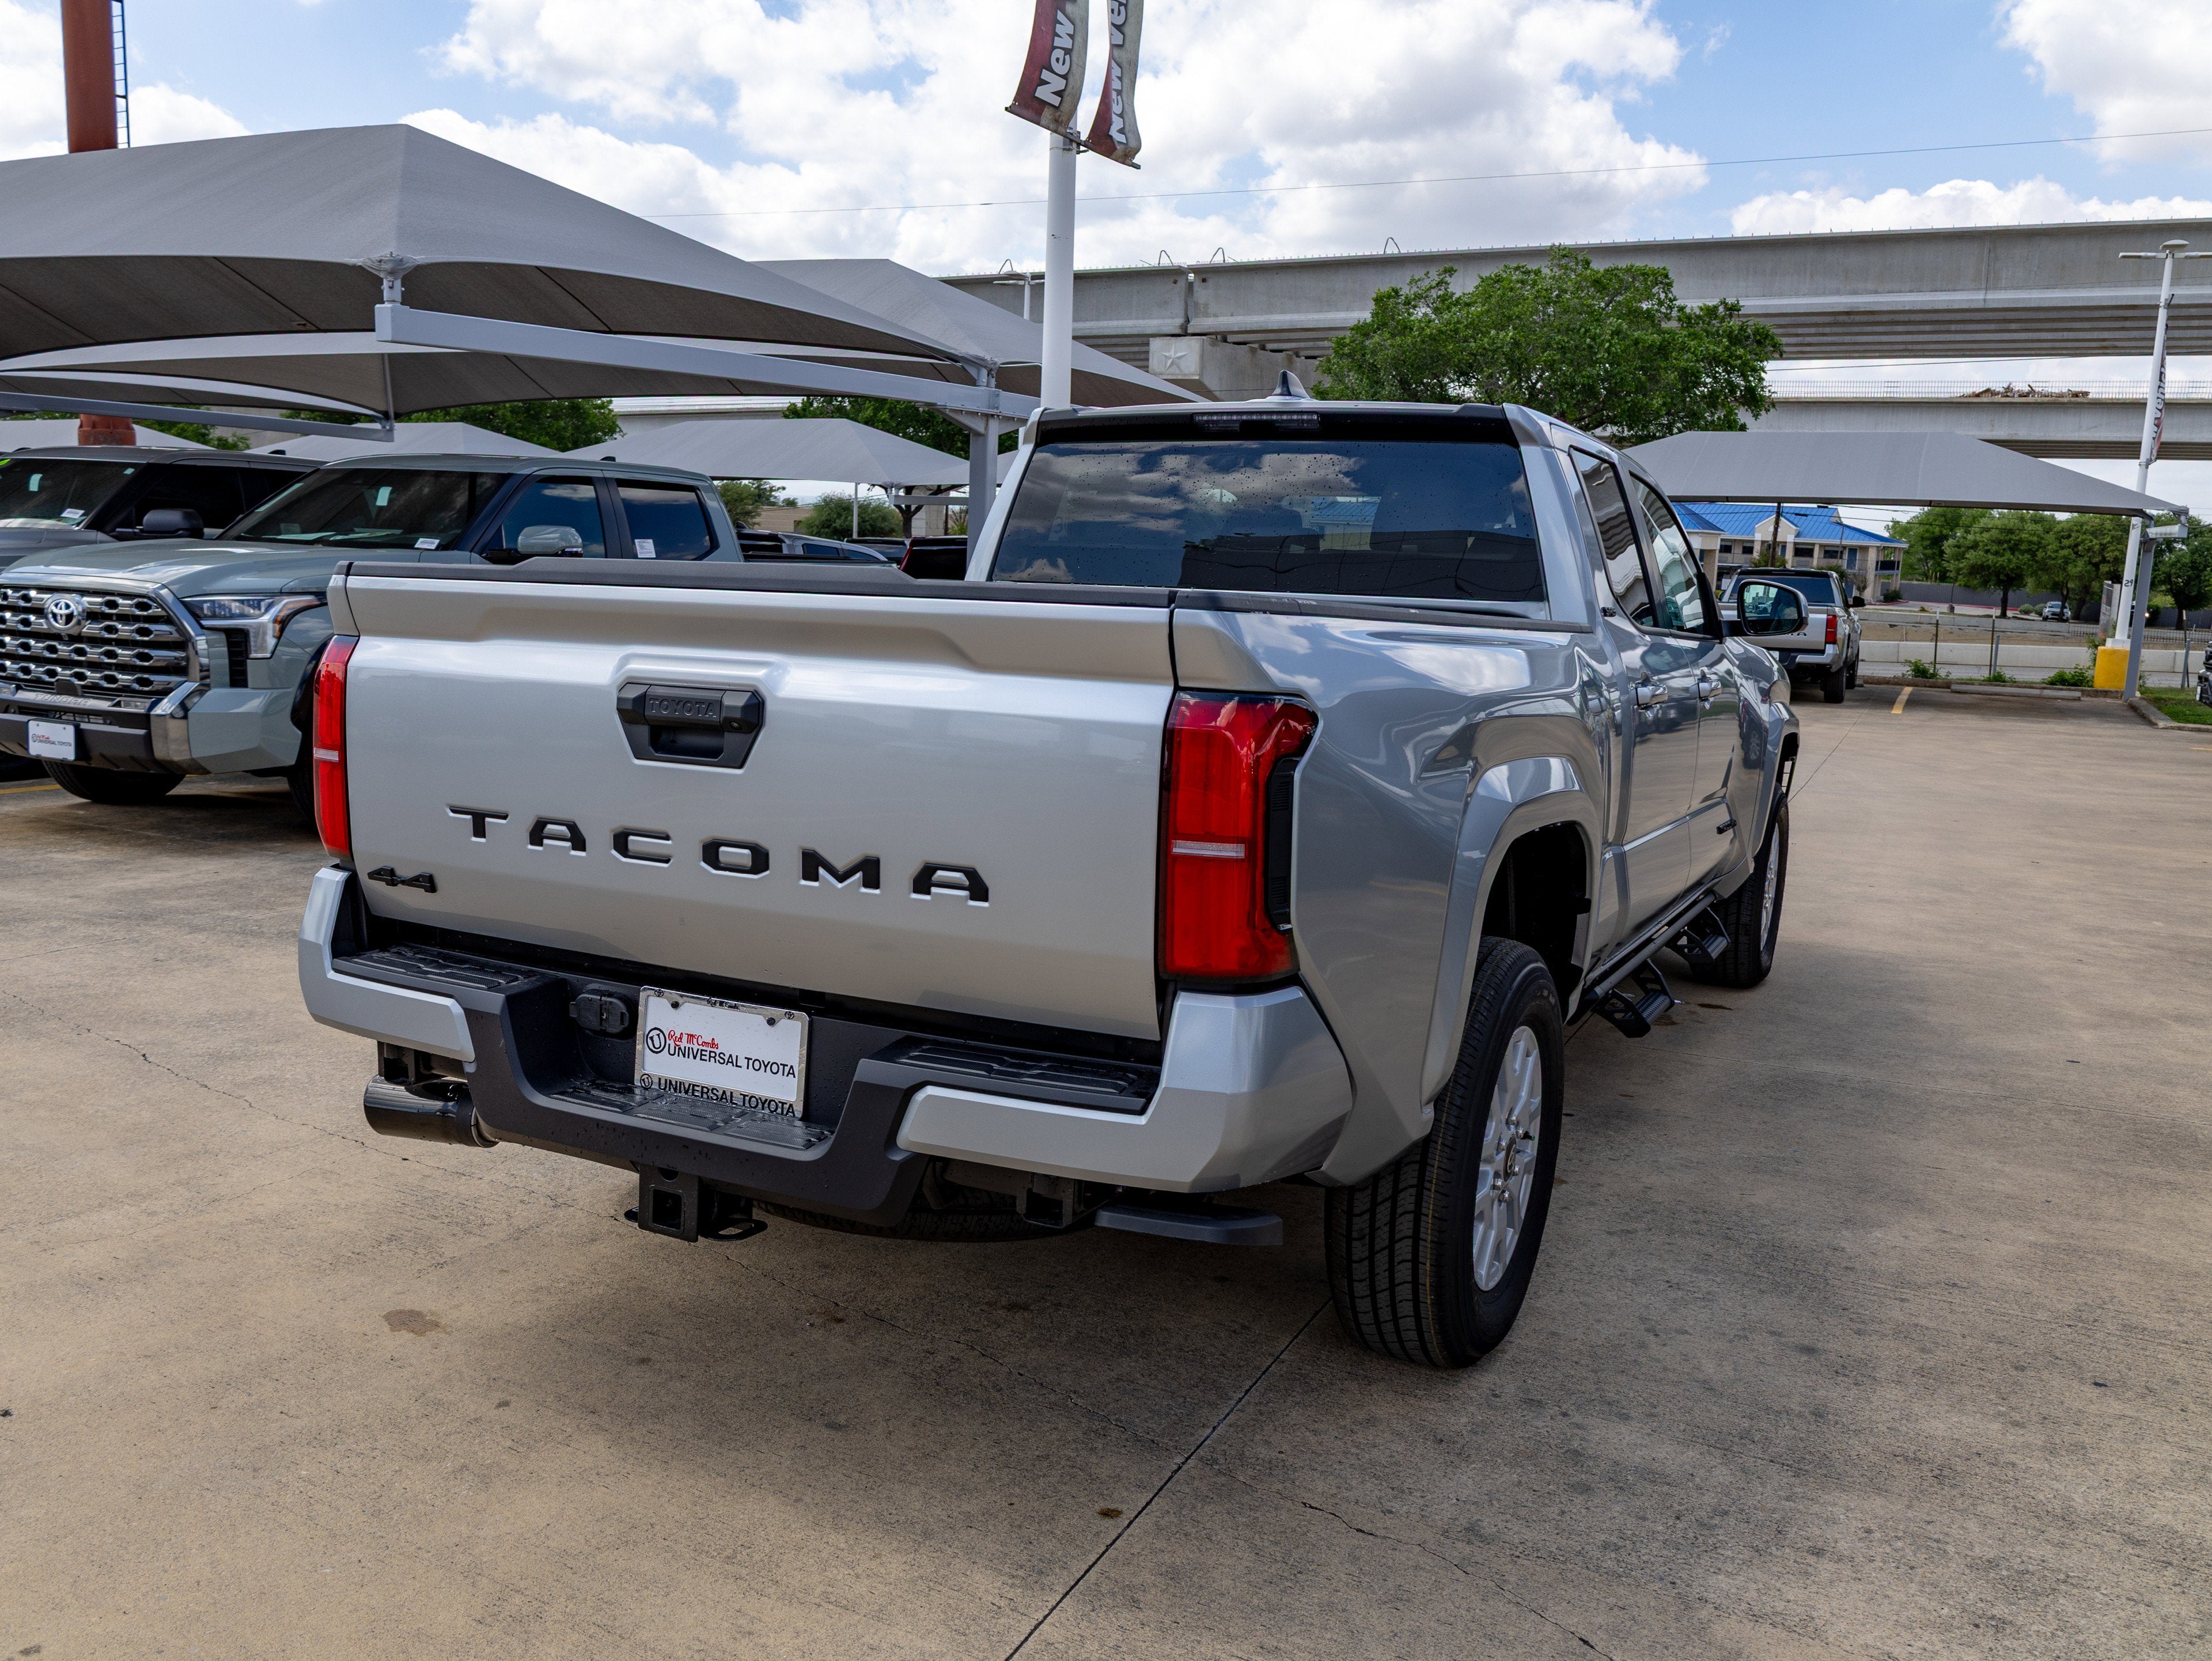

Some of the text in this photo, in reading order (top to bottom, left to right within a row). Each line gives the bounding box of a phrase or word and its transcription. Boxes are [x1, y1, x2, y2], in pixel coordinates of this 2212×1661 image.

[1035, 9, 1074, 107] New
[1109, 0, 1127, 143] New Ve
[649, 698, 717, 718] TOYOTA
[446, 805, 990, 906] TACOMA
[668, 1030, 719, 1050] Red McCombs
[668, 1043, 796, 1079] UNIVERSAL TOYOTA
[658, 1077, 738, 1106] UNIVERSAL
[740, 1094, 796, 1117] TOYOTA
